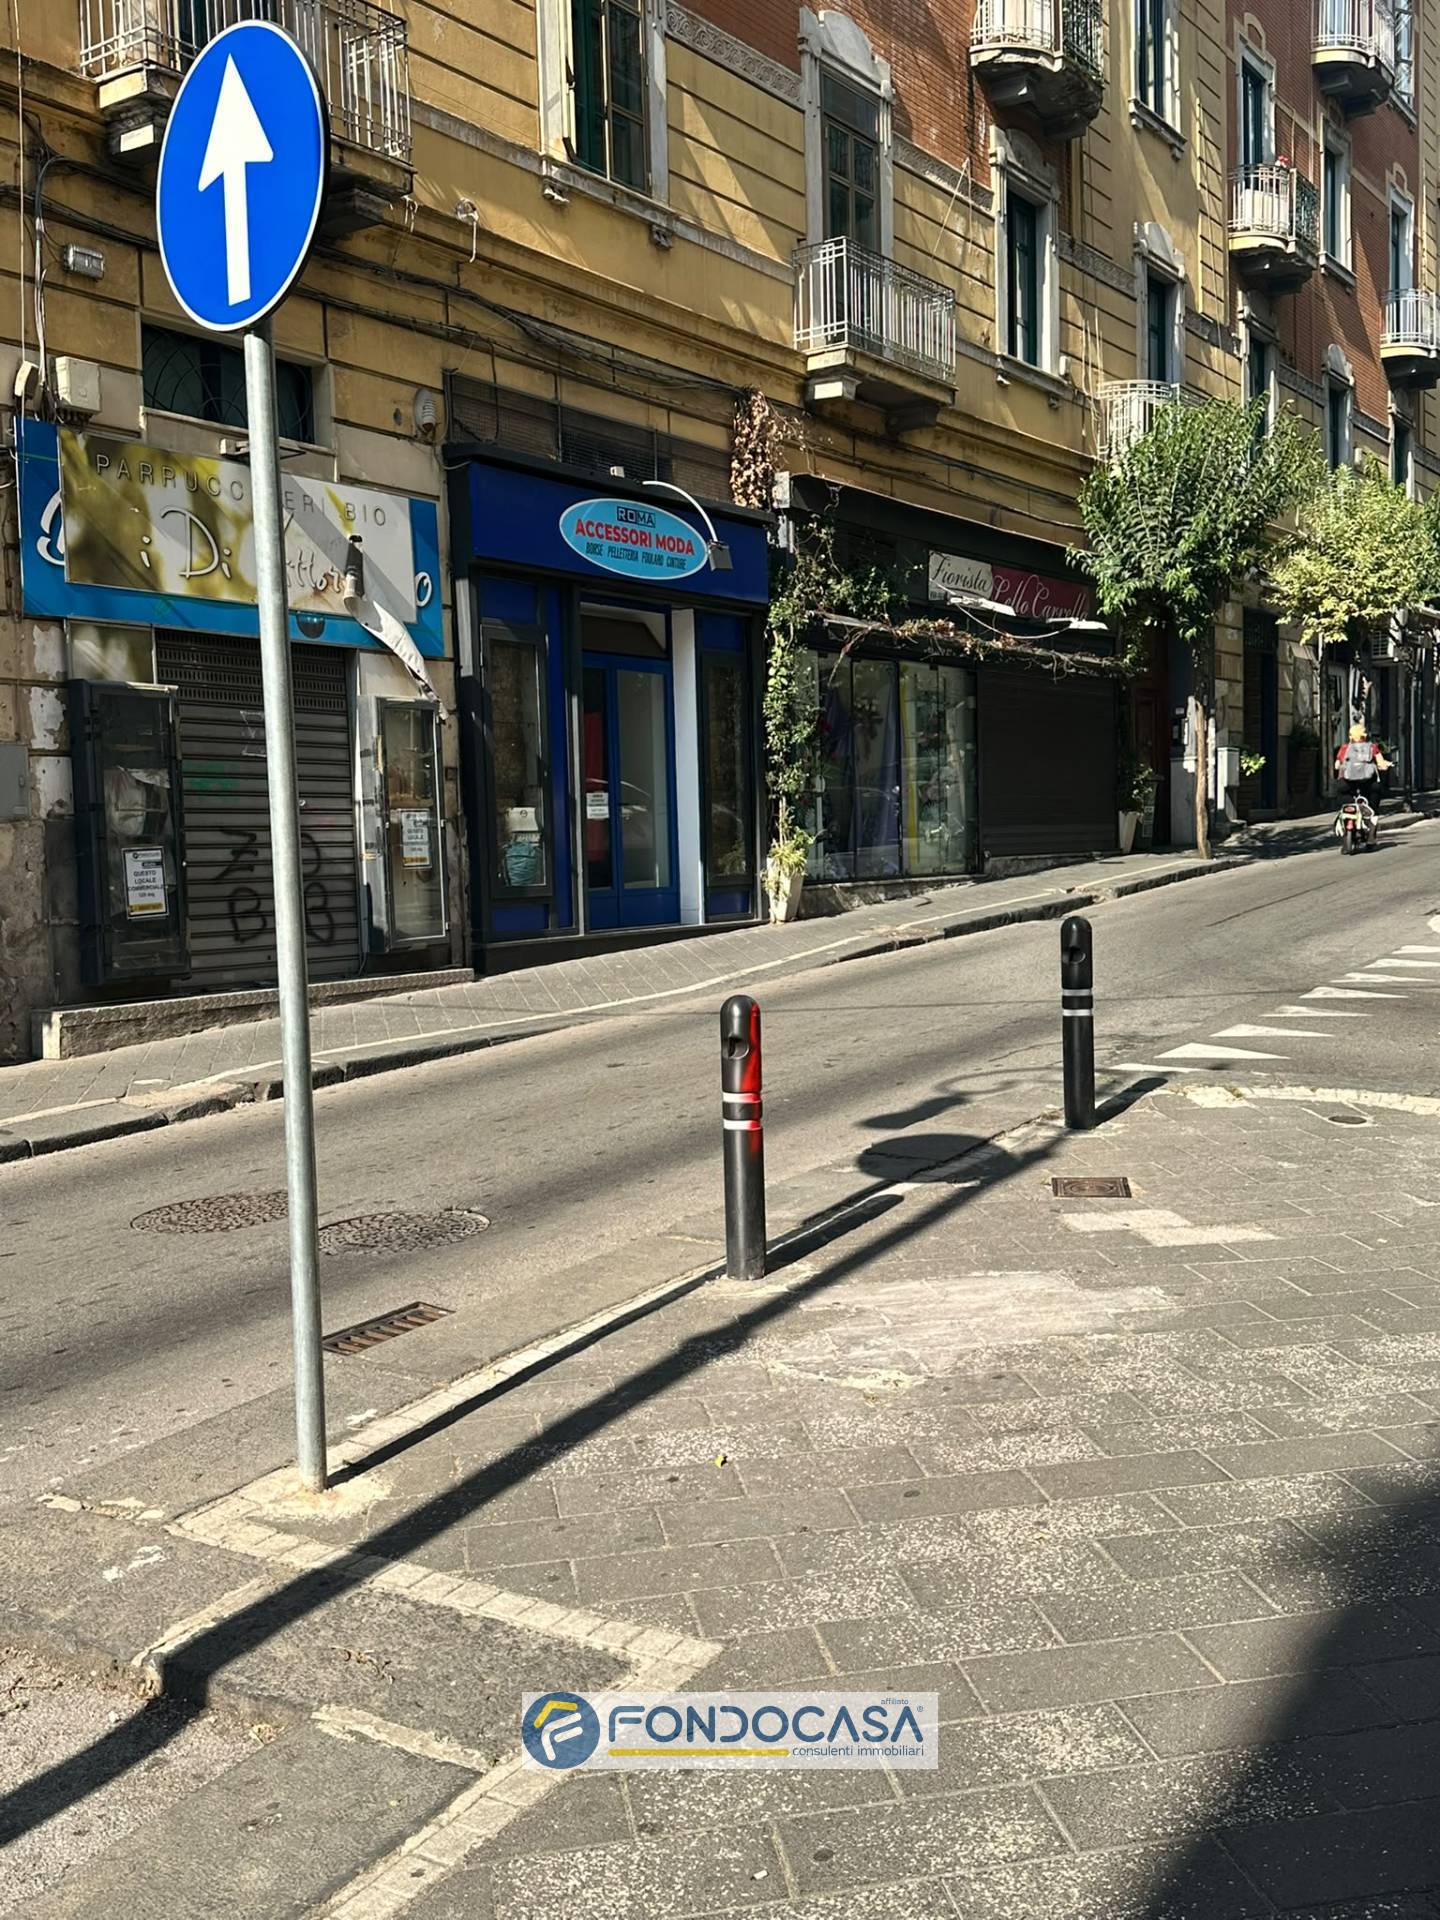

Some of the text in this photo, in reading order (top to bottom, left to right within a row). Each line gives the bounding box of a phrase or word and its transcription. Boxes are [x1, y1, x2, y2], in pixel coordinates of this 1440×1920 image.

[344, 502, 387, 526] BIO
[617, 508, 655, 526] ROMA
[160, 505, 232, 580] Di
[575, 518, 695, 556] ACCESSORI MODA
[585, 541, 687, 570] BORSE PELLETTERIA FOULARD CINTURE
[930, 551, 992, 593] Fiorista
